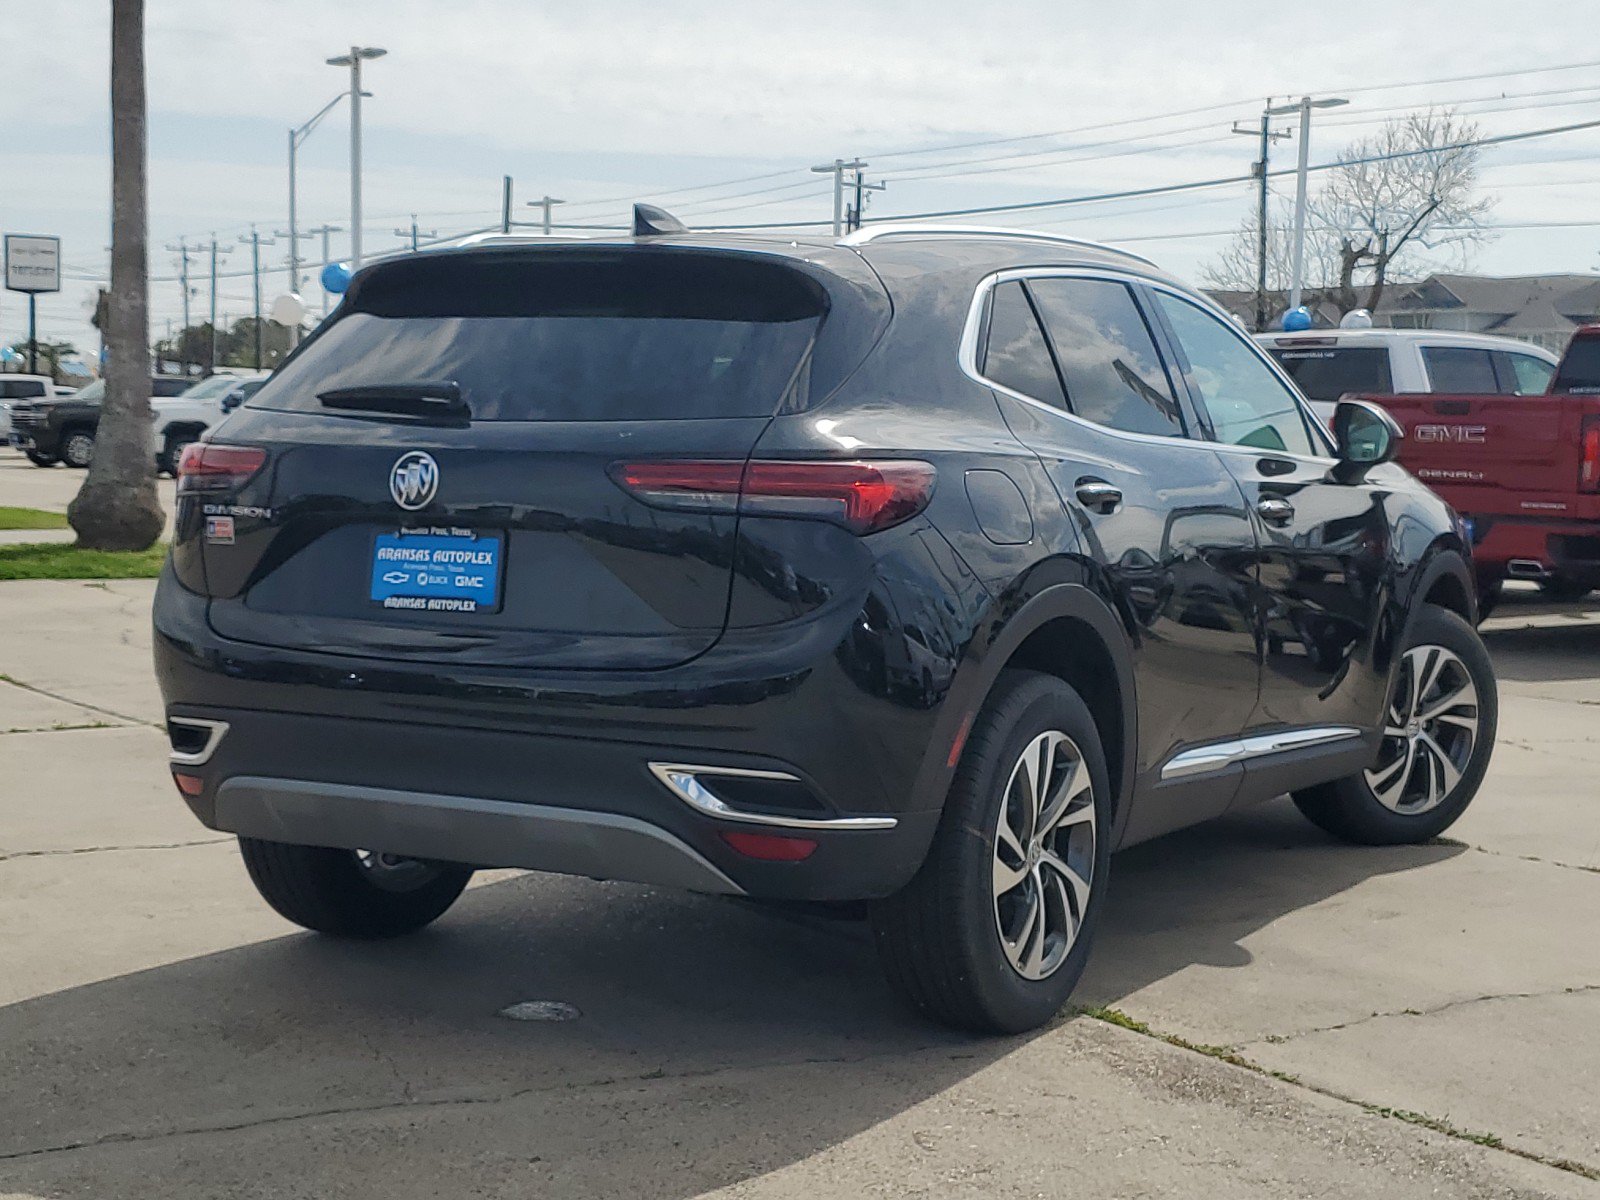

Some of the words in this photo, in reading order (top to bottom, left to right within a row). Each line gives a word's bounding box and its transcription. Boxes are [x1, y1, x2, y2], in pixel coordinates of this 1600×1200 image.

[1414, 425, 1487, 443] GMC
[1418, 469, 1485, 480] DENALI
[377, 548, 430, 562] ARANSAS
[432, 550, 493, 565] AUTOPLEX
[455, 576, 484, 588] GMC
[383, 597, 427, 609] ARANSAS
[427, 599, 476, 612] AUTOPLEX
